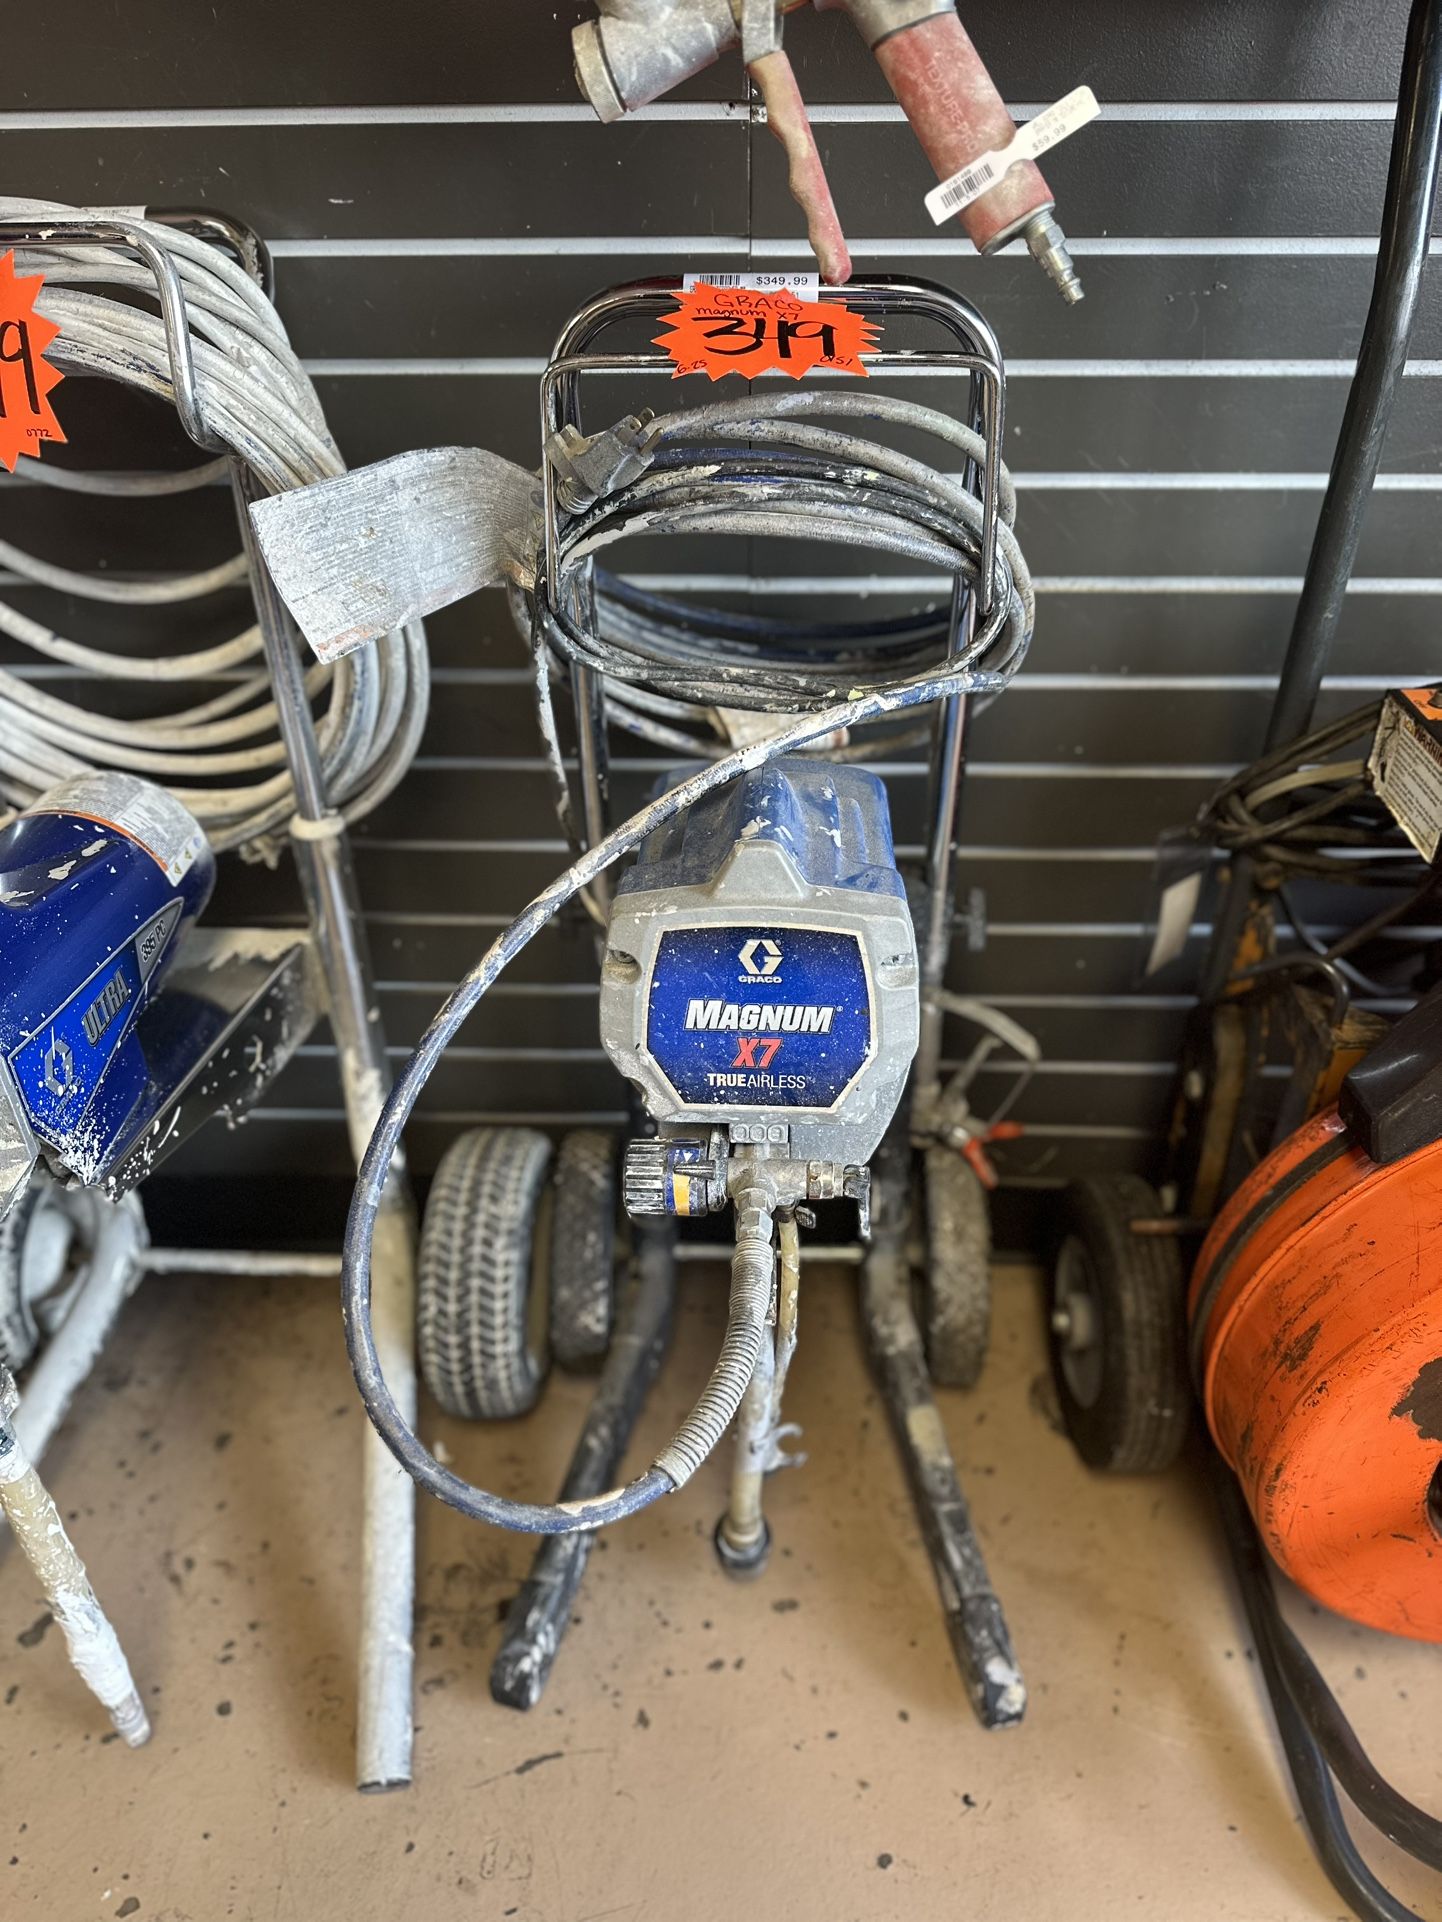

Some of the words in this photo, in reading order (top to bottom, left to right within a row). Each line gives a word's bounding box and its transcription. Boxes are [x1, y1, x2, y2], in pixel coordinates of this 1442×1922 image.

[1032, 123, 1068, 152] $59.99
[756, 275, 808, 286] $349.99
[714, 294, 803, 311] GRACO
[696, 307, 767, 319] magnum
[691, 315, 838, 360] 349
[26, 428, 53, 438] 0772
[156, 919, 168, 943] PC
[738, 975, 783, 984] GRACO
[81, 968, 131, 1047] ULTRA
[731, 1037, 783, 1068] X7
[707, 1072, 807, 1089] TRUEAIRLESS
